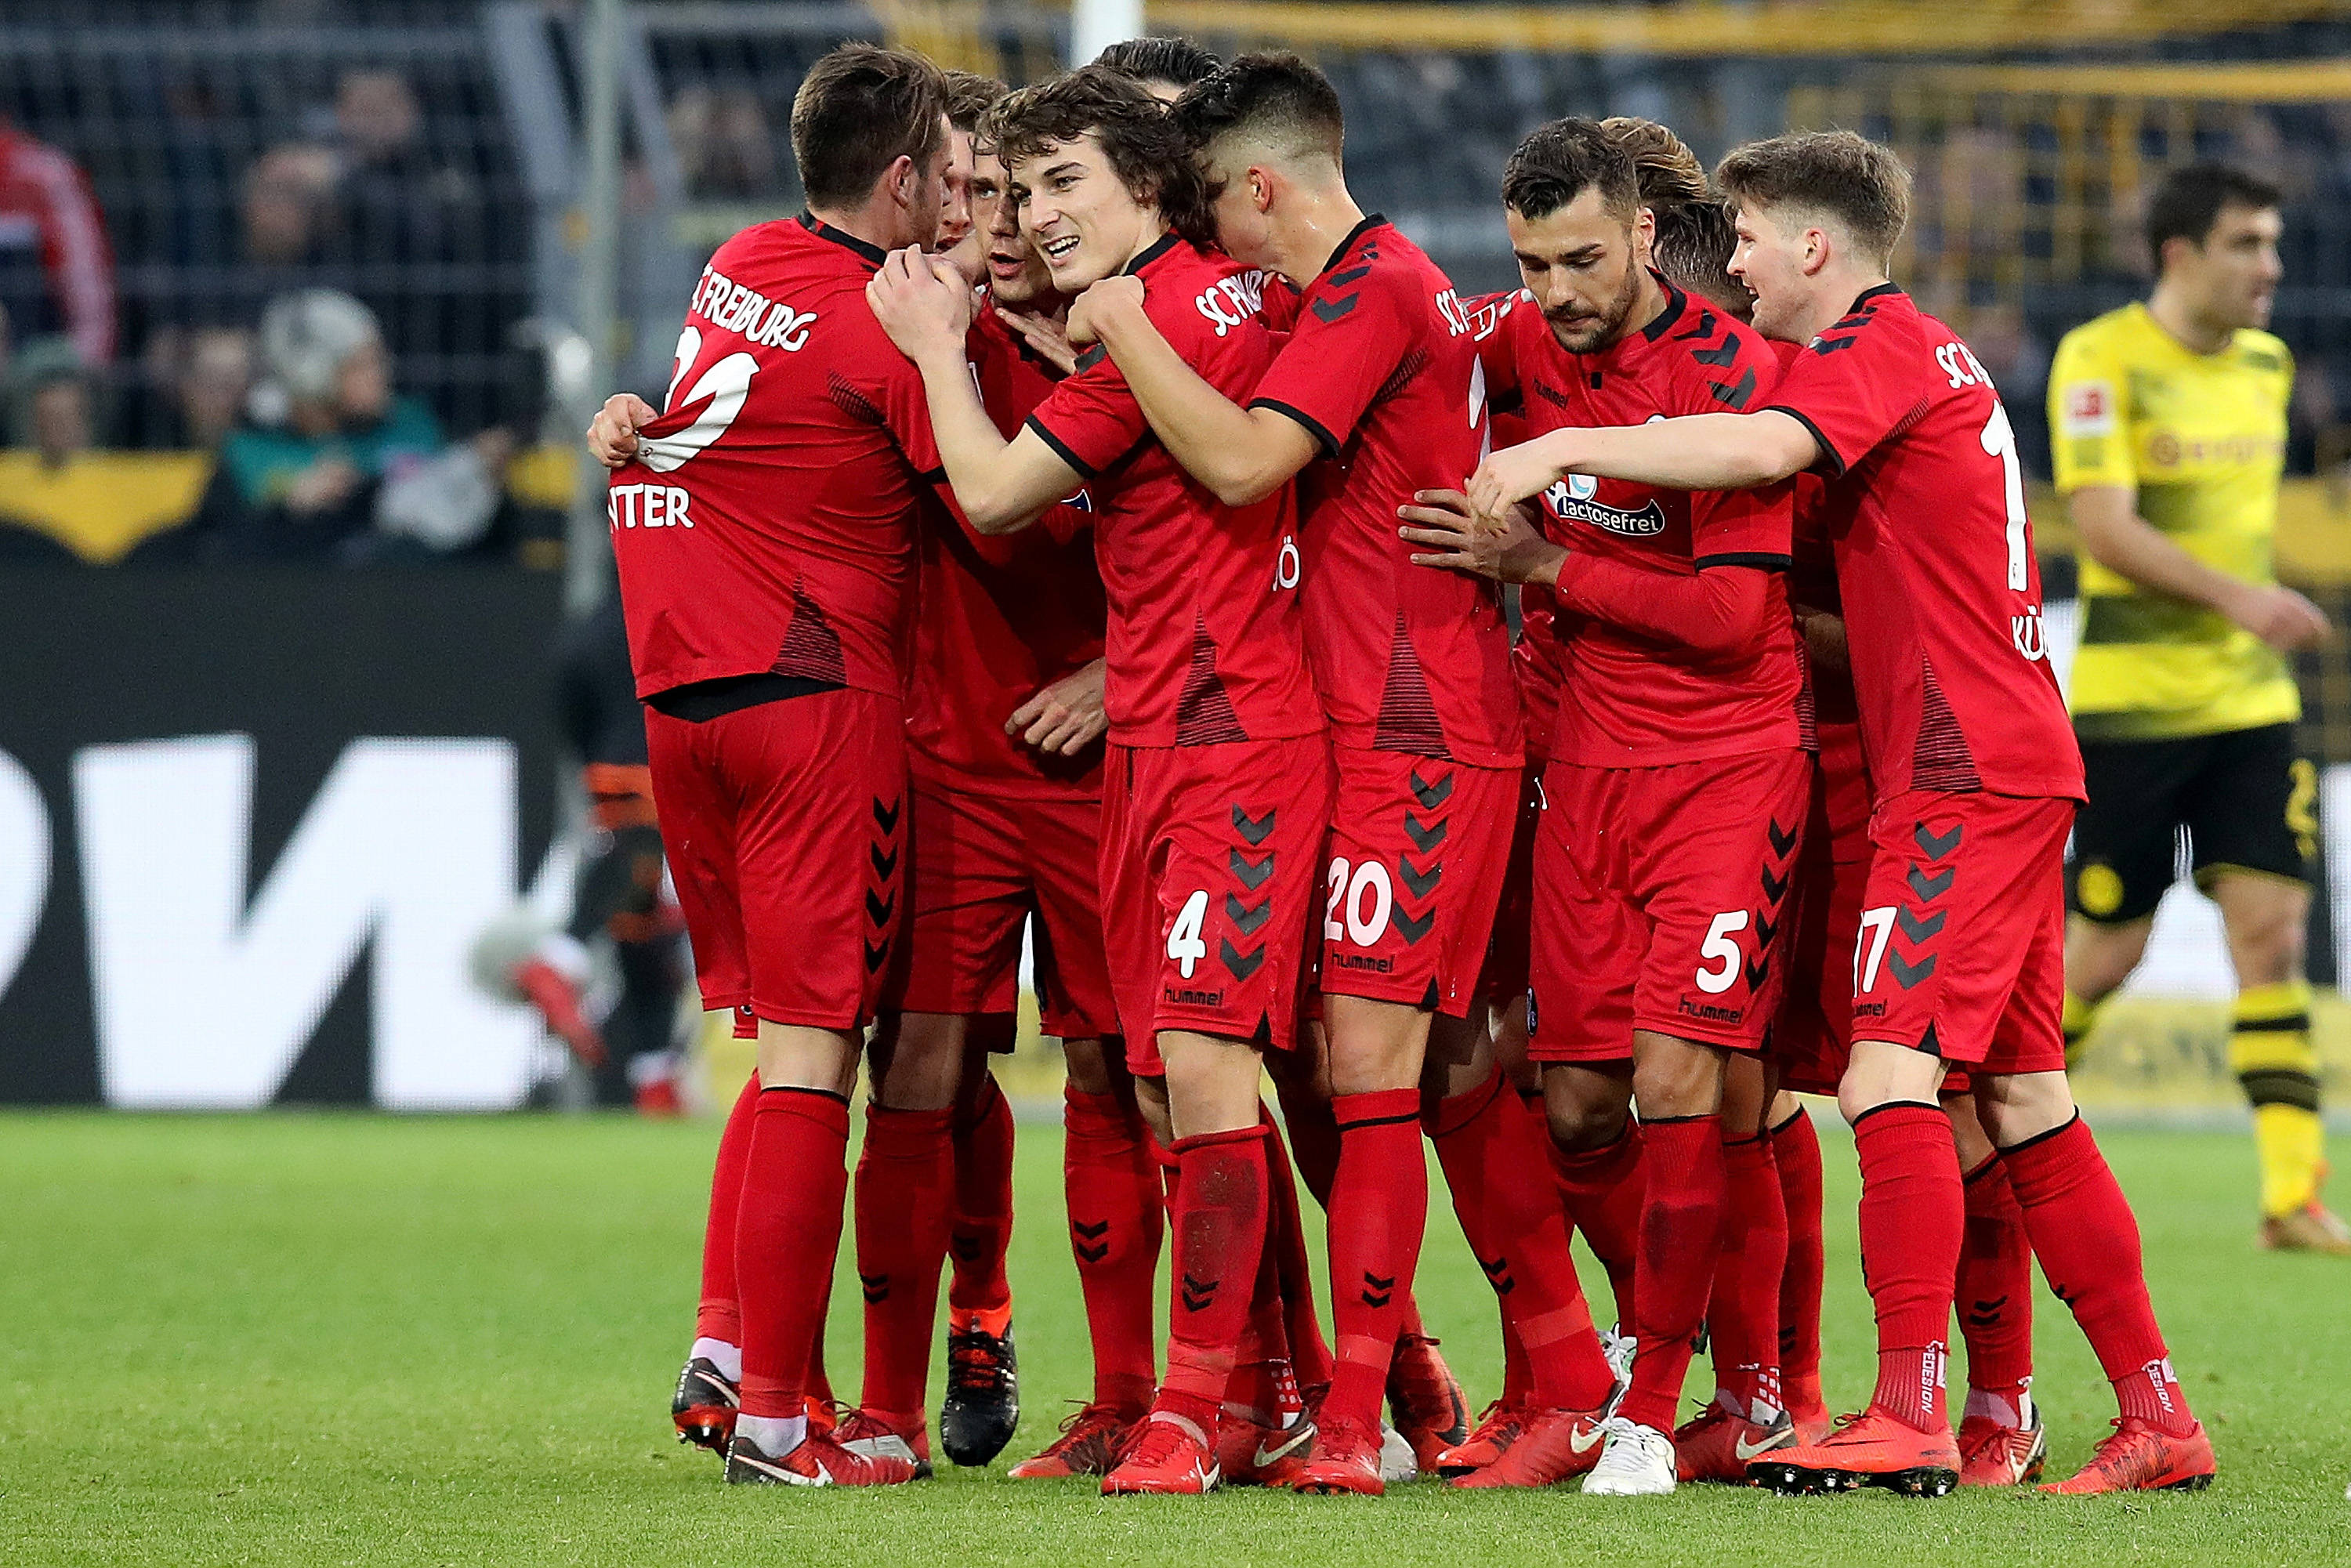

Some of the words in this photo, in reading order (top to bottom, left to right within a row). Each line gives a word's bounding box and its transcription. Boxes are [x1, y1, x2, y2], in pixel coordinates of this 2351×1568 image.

[697, 271, 819, 352] FREIBURG
[1562, 496, 1660, 533] lactosefrei
[2011, 605, 2051, 661] KÜ
[1324, 856, 1394, 947] 20
[1166, 889, 1208, 979] 4
[1331, 947, 1395, 973] hummel
[1694, 910, 1749, 994] 5
[1163, 986, 1225, 1008] hummel
[1678, 994, 1744, 1024] hummel
